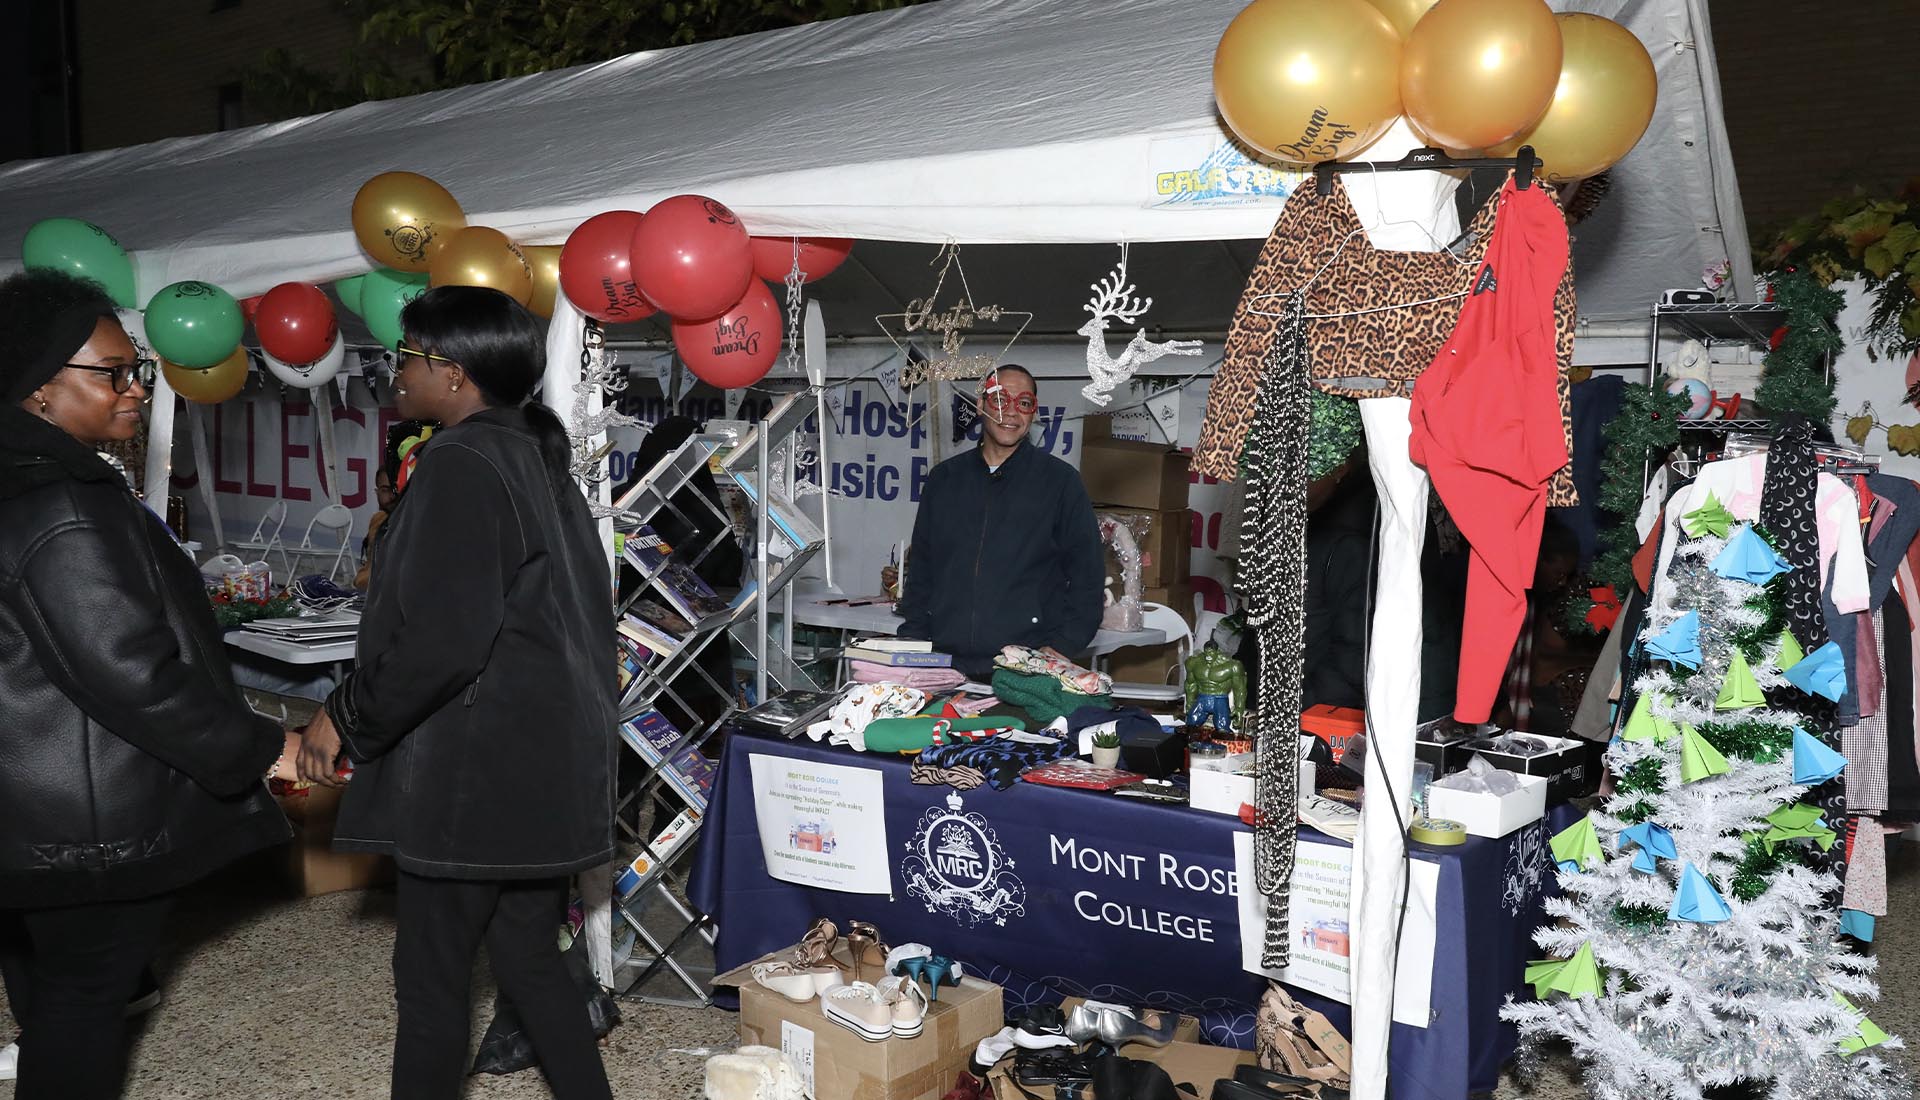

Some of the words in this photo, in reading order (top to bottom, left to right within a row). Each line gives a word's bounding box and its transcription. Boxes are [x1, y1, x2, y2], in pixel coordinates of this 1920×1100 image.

[1274, 105, 1328, 160] Dream
[1309, 122, 1357, 158] Big!
[1414, 154, 1435, 162] next
[602, 276, 630, 317] Dream
[615, 281, 645, 308] Big!
[712, 331, 760, 356] Dream
[715, 315, 749, 345] Big!
[650, 729, 681, 750] English
[936, 854, 984, 880] MRC
[1050, 833, 1146, 882] MONT
[1074, 890, 1216, 944] COLLEGE
